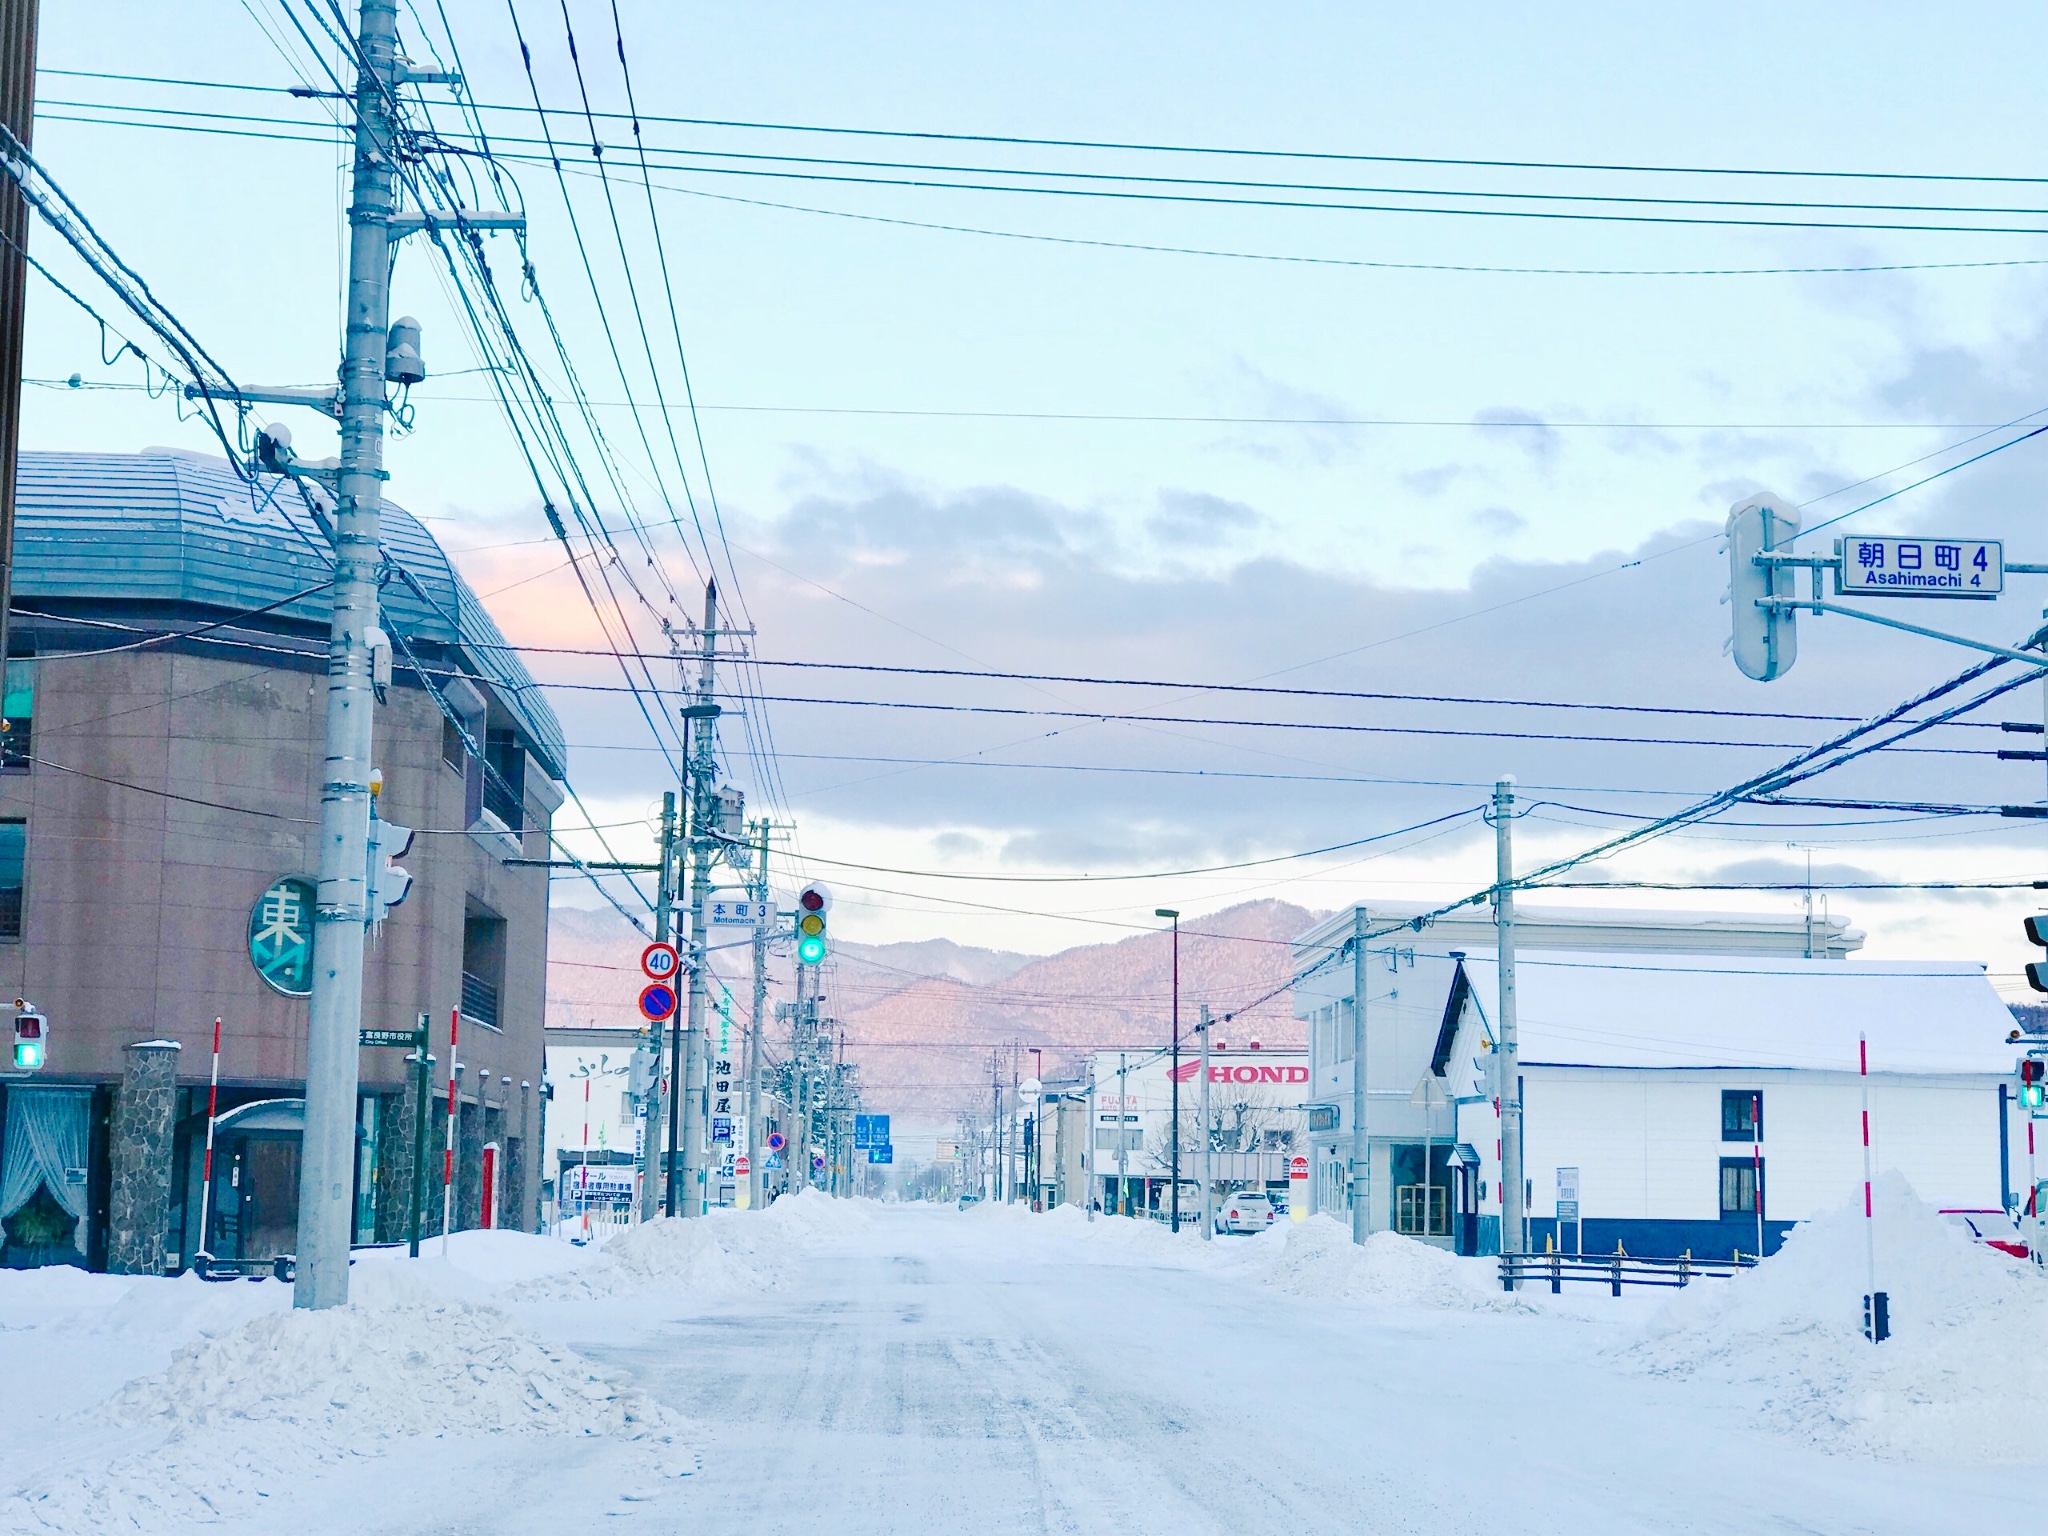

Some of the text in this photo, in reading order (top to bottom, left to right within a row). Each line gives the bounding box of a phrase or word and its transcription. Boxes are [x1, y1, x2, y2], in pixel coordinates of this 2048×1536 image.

[1865, 571, 1982, 588] Asahimachi 4
[713, 916, 756, 924] Motomachi
[649, 953, 671, 971] 40
[365, 1031, 413, 1041] 富良野市役所
[1208, 1066, 1309, 1084] HOND
[715, 1060, 731, 1114] 池田屋
[1101, 1096, 1138, 1105] FUJTA
